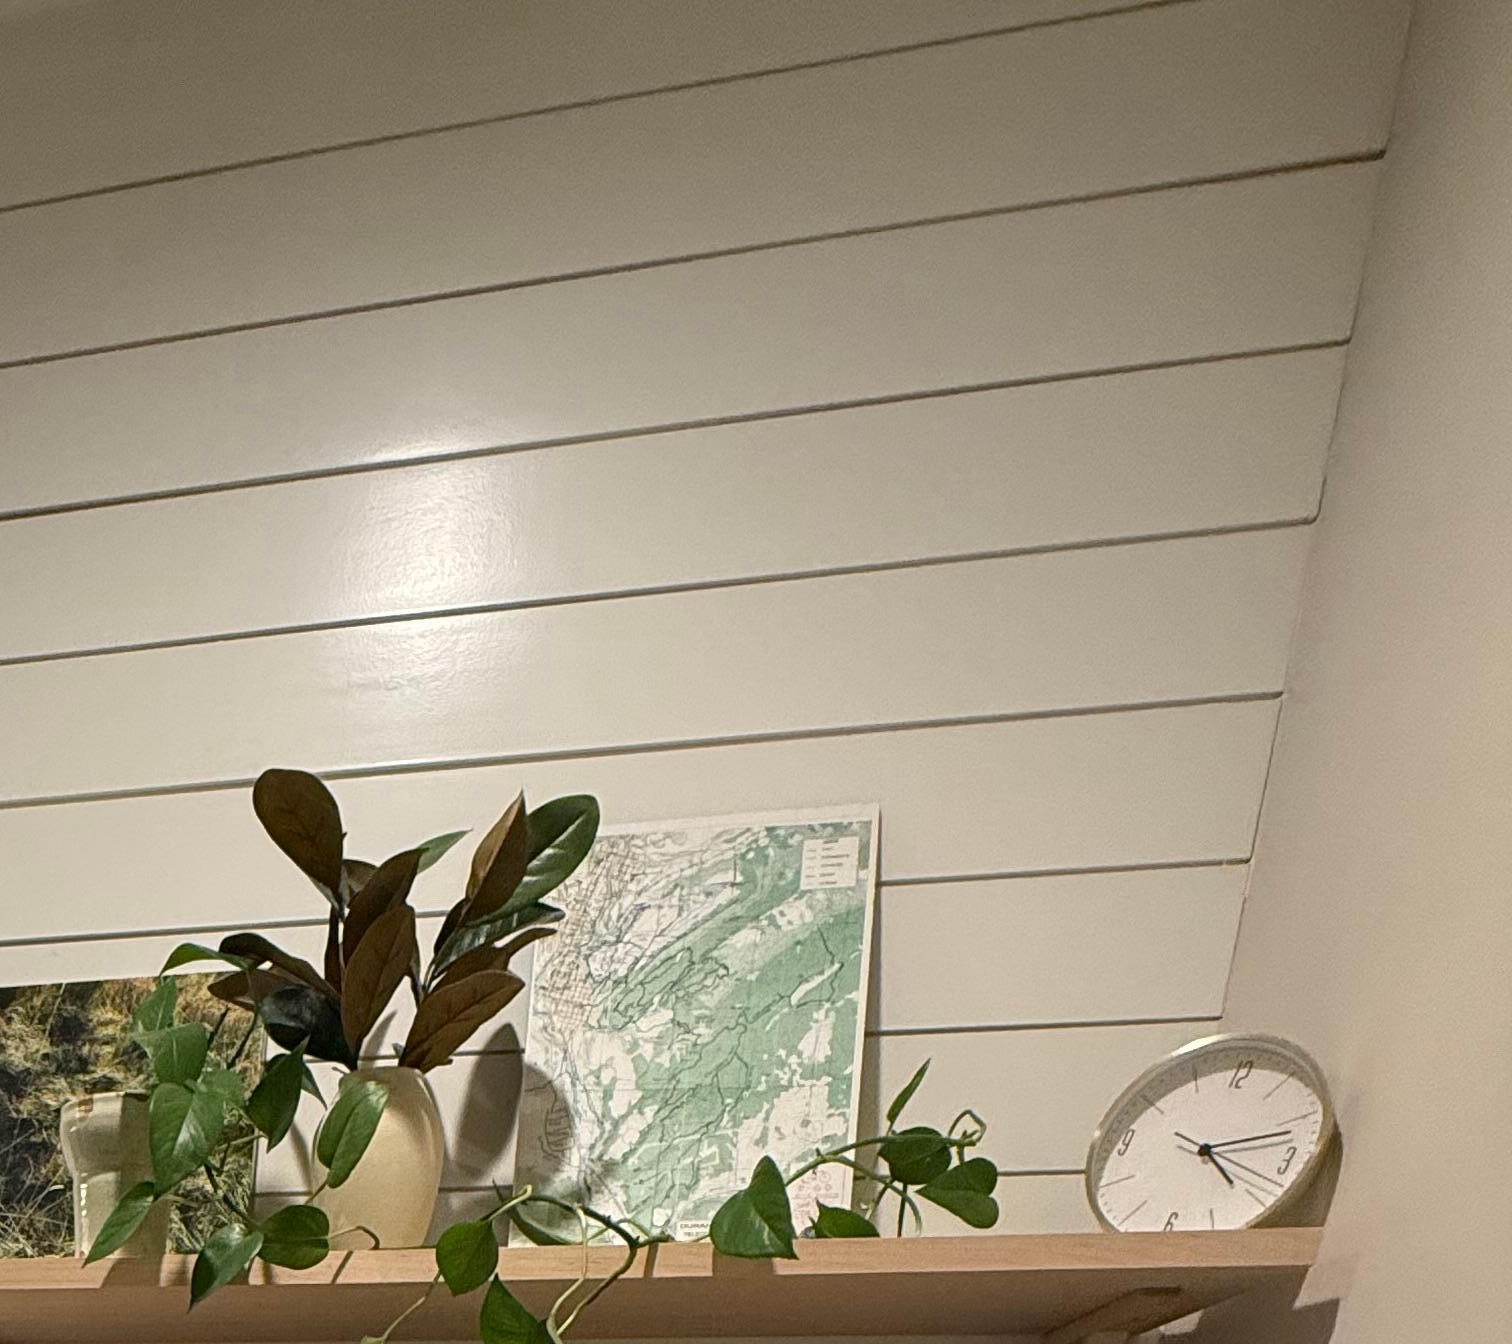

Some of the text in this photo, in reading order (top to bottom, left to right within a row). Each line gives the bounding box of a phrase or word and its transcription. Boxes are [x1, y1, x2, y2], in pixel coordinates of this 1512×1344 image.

[1229, 1060, 1253, 1089] 12
[1117, 1128, 1135, 1156] 9
[1277, 1146, 1297, 1175] 3
